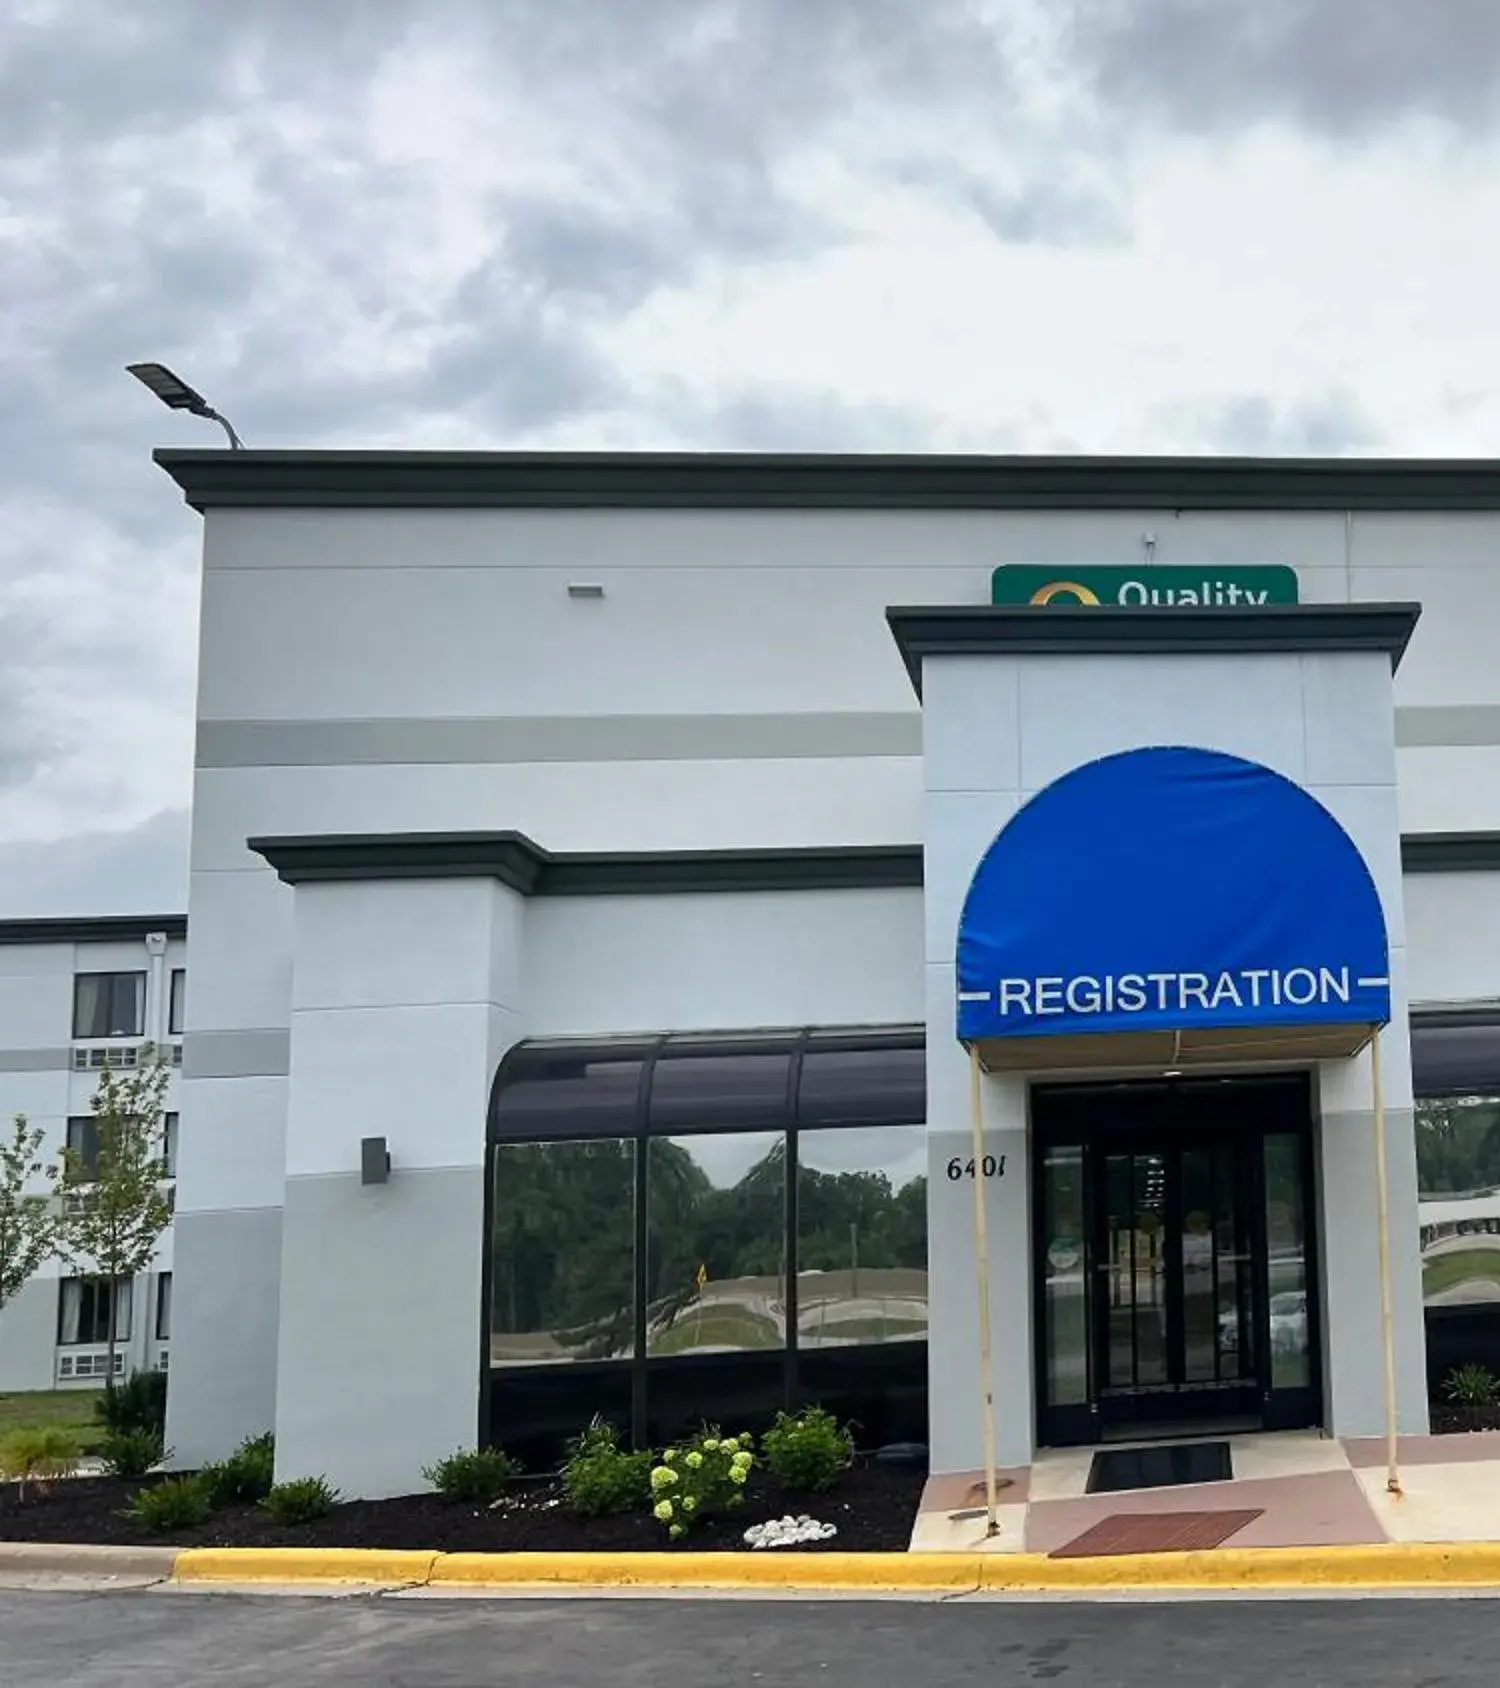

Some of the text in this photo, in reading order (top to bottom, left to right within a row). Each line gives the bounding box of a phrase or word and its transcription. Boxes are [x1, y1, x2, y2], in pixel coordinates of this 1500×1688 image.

[1117, 581, 1268, 606] Quality
[1000, 966, 1349, 1015] REGISTRATION
[947, 1155, 1006, 1181] 6401
